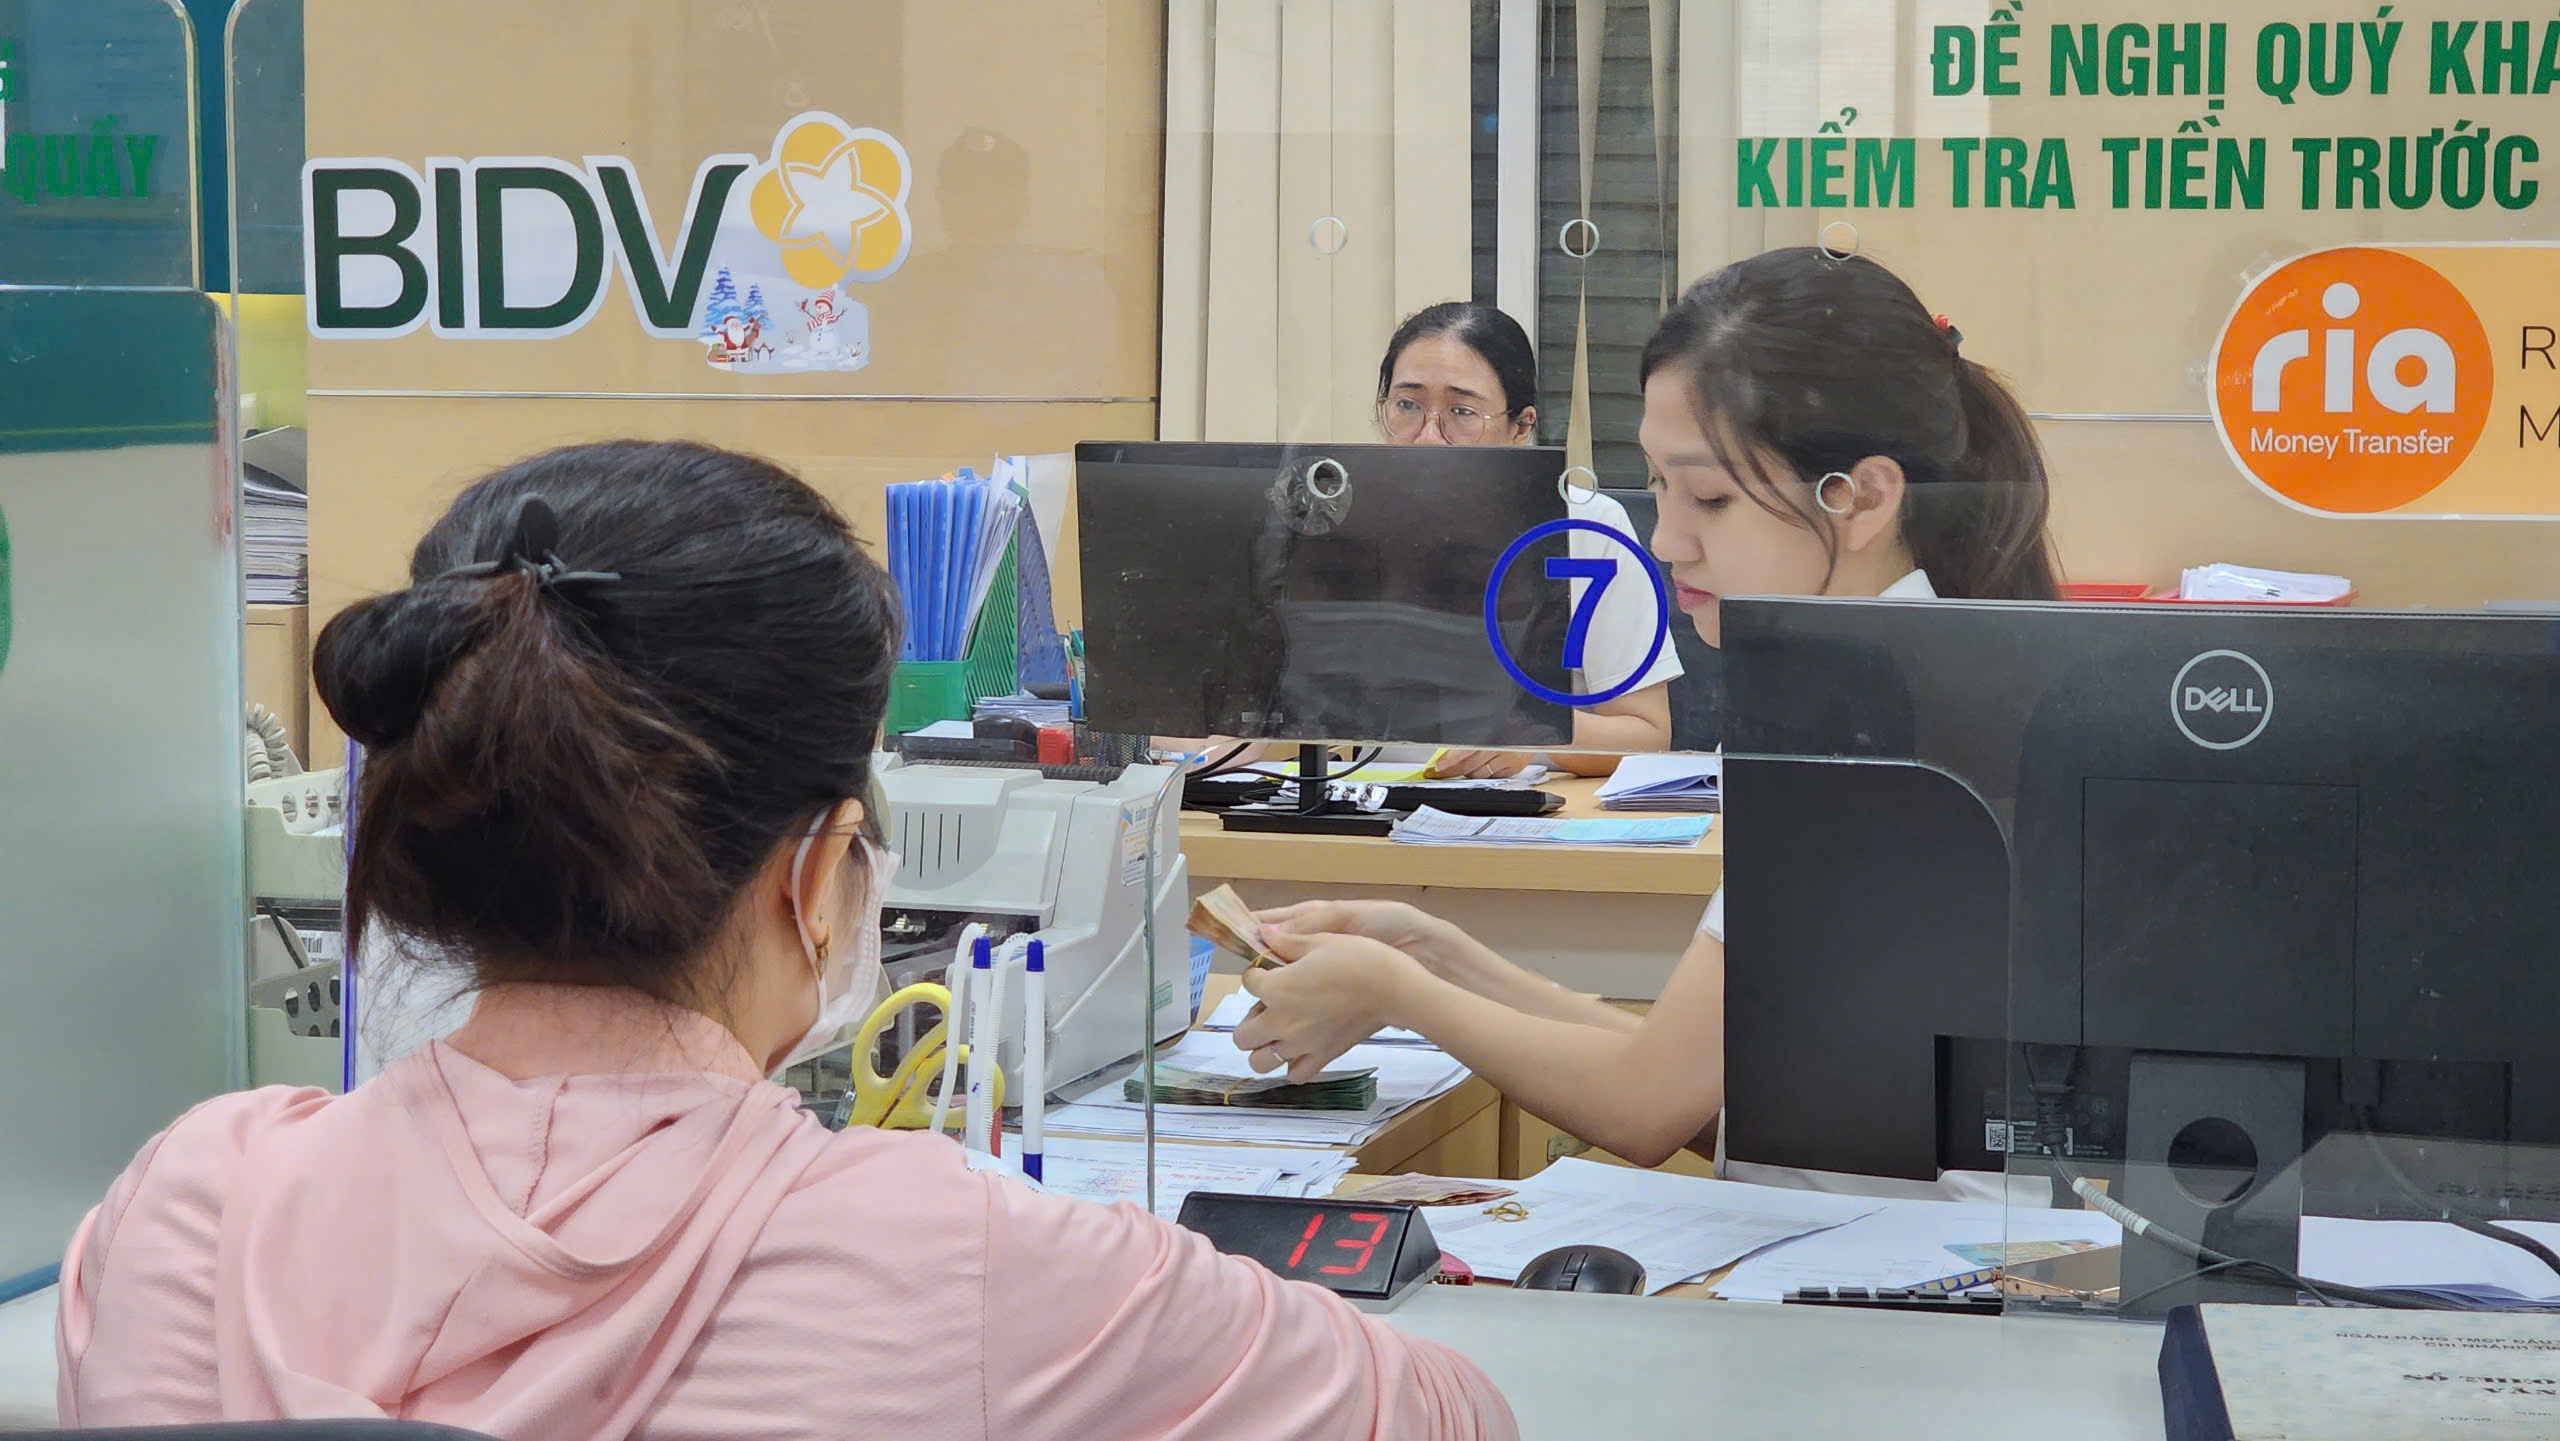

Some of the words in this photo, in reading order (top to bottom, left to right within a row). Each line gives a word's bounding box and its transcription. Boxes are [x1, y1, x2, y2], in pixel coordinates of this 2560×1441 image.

[1930, 0, 2023, 96] ĐỀ
[2050, 22, 2227, 110] NGHỊ
[2256, 6, 2403, 104] QUÝ
[6, 113, 157, 206] QUẤY
[1737, 106, 1916, 208] KIỂM
[1942, 137, 2076, 209] TRA
[2102, 115, 2267, 209] TIỀN
[2293, 119, 2540, 209] TRƯỚC
[312, 164, 750, 329] BIDV
[2252, 281, 2456, 414] ria
[2250, 428, 2338, 459] Money
[2343, 428, 2454, 454] Transfer
[1546, 557, 1618, 669] 7
[2185, 686, 2263, 713] DELL
[1287, 1212, 1391, 1276] 13
